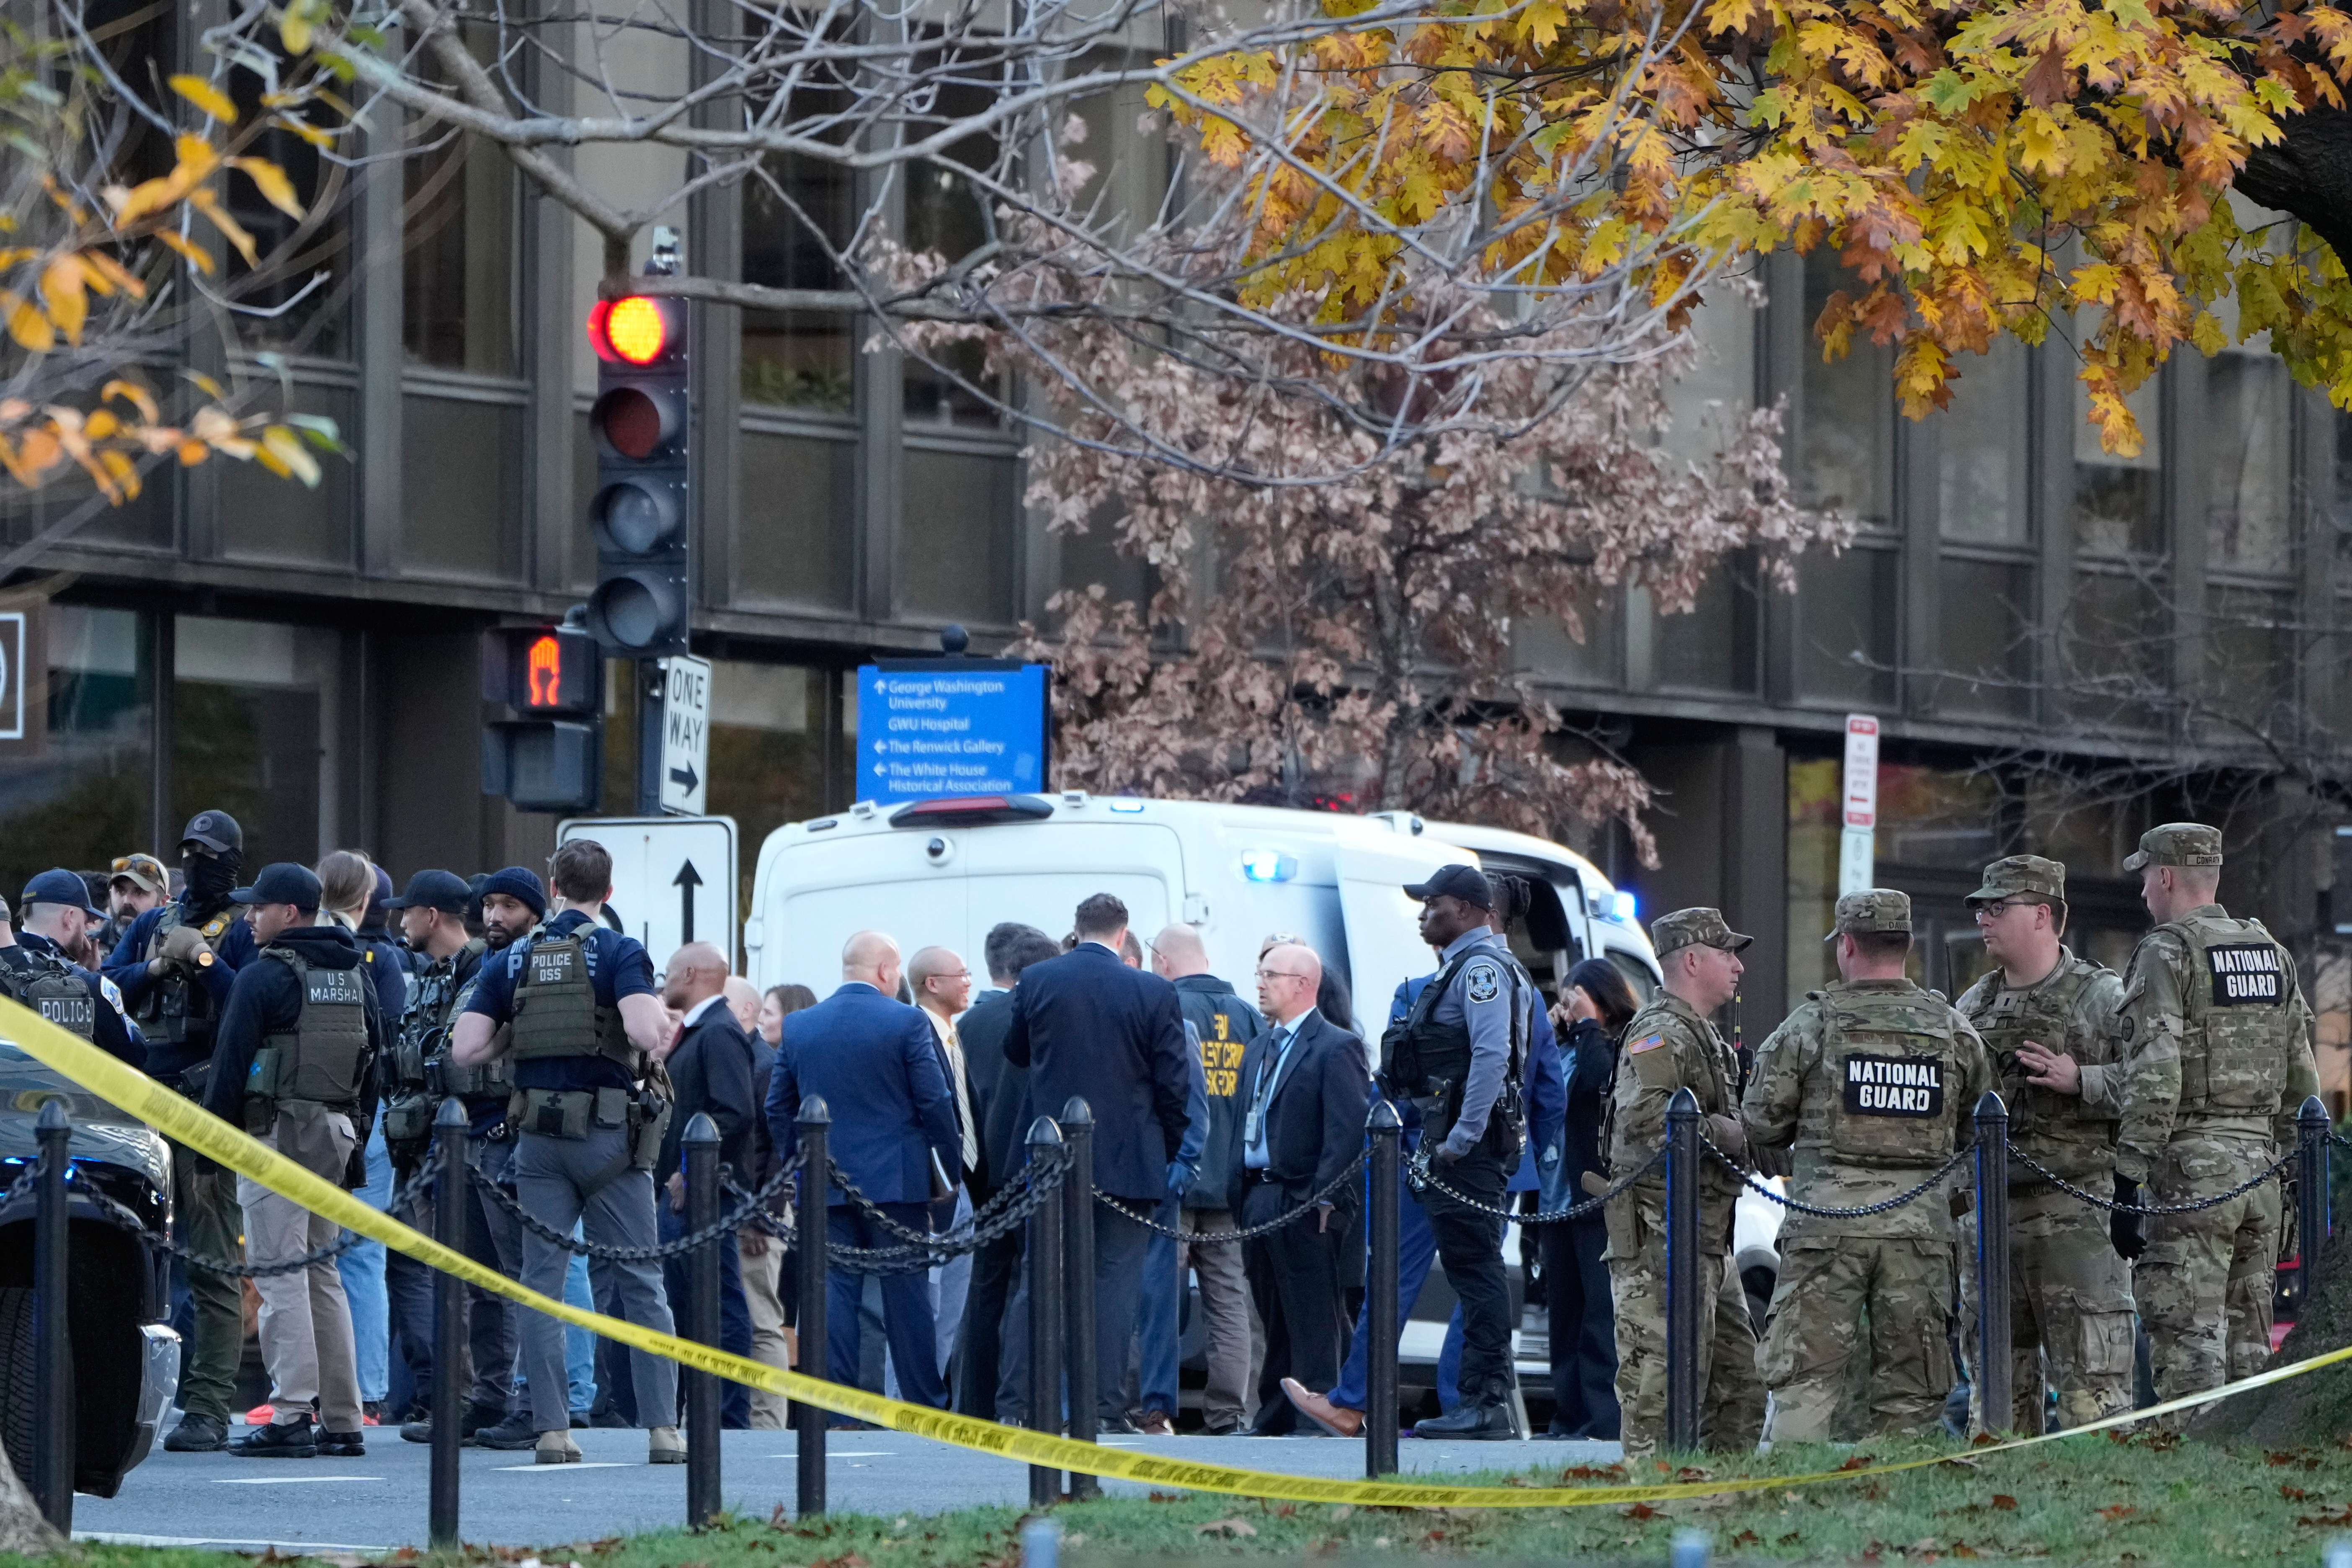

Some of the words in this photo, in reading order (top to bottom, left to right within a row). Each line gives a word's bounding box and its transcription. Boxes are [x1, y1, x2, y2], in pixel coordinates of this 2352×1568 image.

[673, 668, 704, 709] ONE
[889, 681, 933, 696] George
[934, 680, 1004, 696] Washington
[889, 697, 946, 712] University
[670, 711, 702, 753] WAY
[888, 717, 920, 731] GWU
[921, 717, 970, 732] Hospital
[890, 740, 911, 753] The
[913, 740, 960, 753] Renwick
[963, 740, 1004, 756] Gallery
[890, 763, 911, 776] The
[913, 763, 947, 776] White
[949, 763, 988, 776] House
[889, 779, 943, 792] Historical
[945, 779, 1013, 792] Association
[532, 953, 571, 968] POLICE
[2213, 949, 2279, 972] NATIONAL
[327, 972, 348, 986] U.S.
[540, 968, 561, 982] DSS
[2226, 974, 2276, 997] GUARD
[310, 988, 363, 1003] MARSHAL
[42, 1001, 92, 1022] POLICE
[1849, 1061, 1940, 1088] NATIONAL
[1859, 1085, 1930, 1111] GUARD
